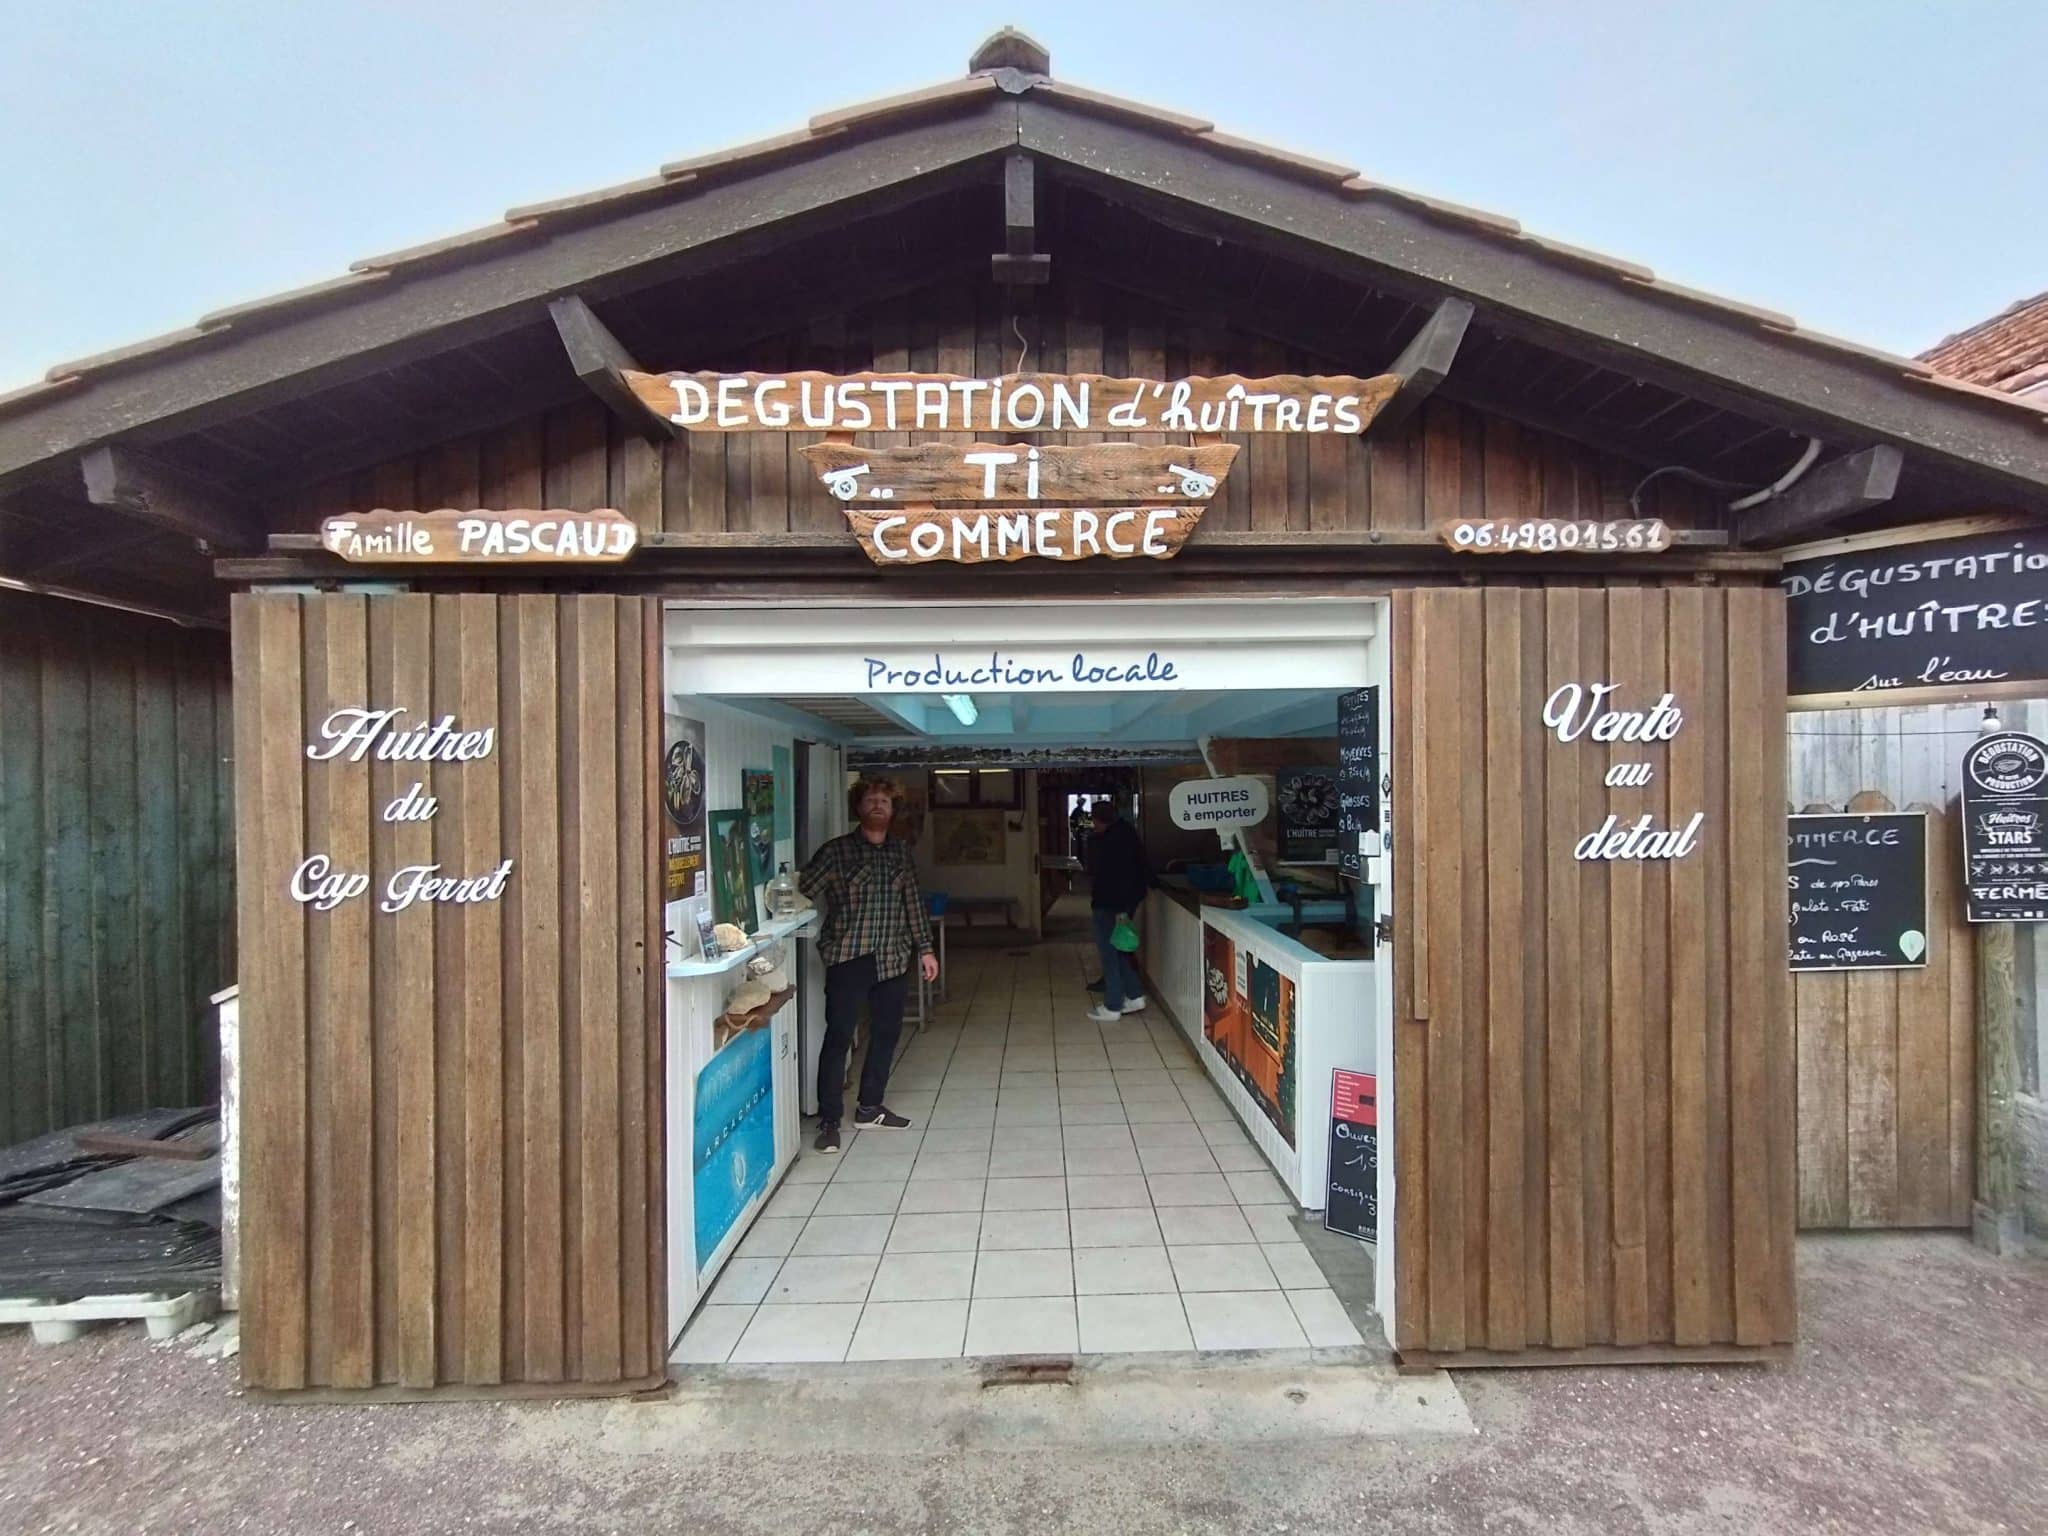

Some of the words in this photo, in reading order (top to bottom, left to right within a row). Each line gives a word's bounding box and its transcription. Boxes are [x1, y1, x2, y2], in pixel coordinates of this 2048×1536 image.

[963, 448, 1039, 500] Ti
[457, 519, 637, 557] PASCAUD
[872, 510, 1178, 559] COMMERCE
[863, 650, 1063, 689] Production
[1072, 651, 1179, 683] locale
[1853, 674, 1904, 692] sur
[1542, 682, 1683, 742] Vente
[306, 706, 496, 762] Huîtres
[1604, 762, 1654, 787] au
[383, 782, 439, 822] du
[1183, 810, 1191, 821] à
[1195, 807, 1257, 821] emporter
[1187, 789, 1250, 806] HUITRES
[1573, 811, 1705, 861] détail
[1988, 831, 2033, 845] STARS
[290, 854, 370, 911] Cap
[381, 859, 514, 913] Ferret
[1822, 926, 1859, 943] Rosé
[704, 1086, 768, 1159] ARCACHON
